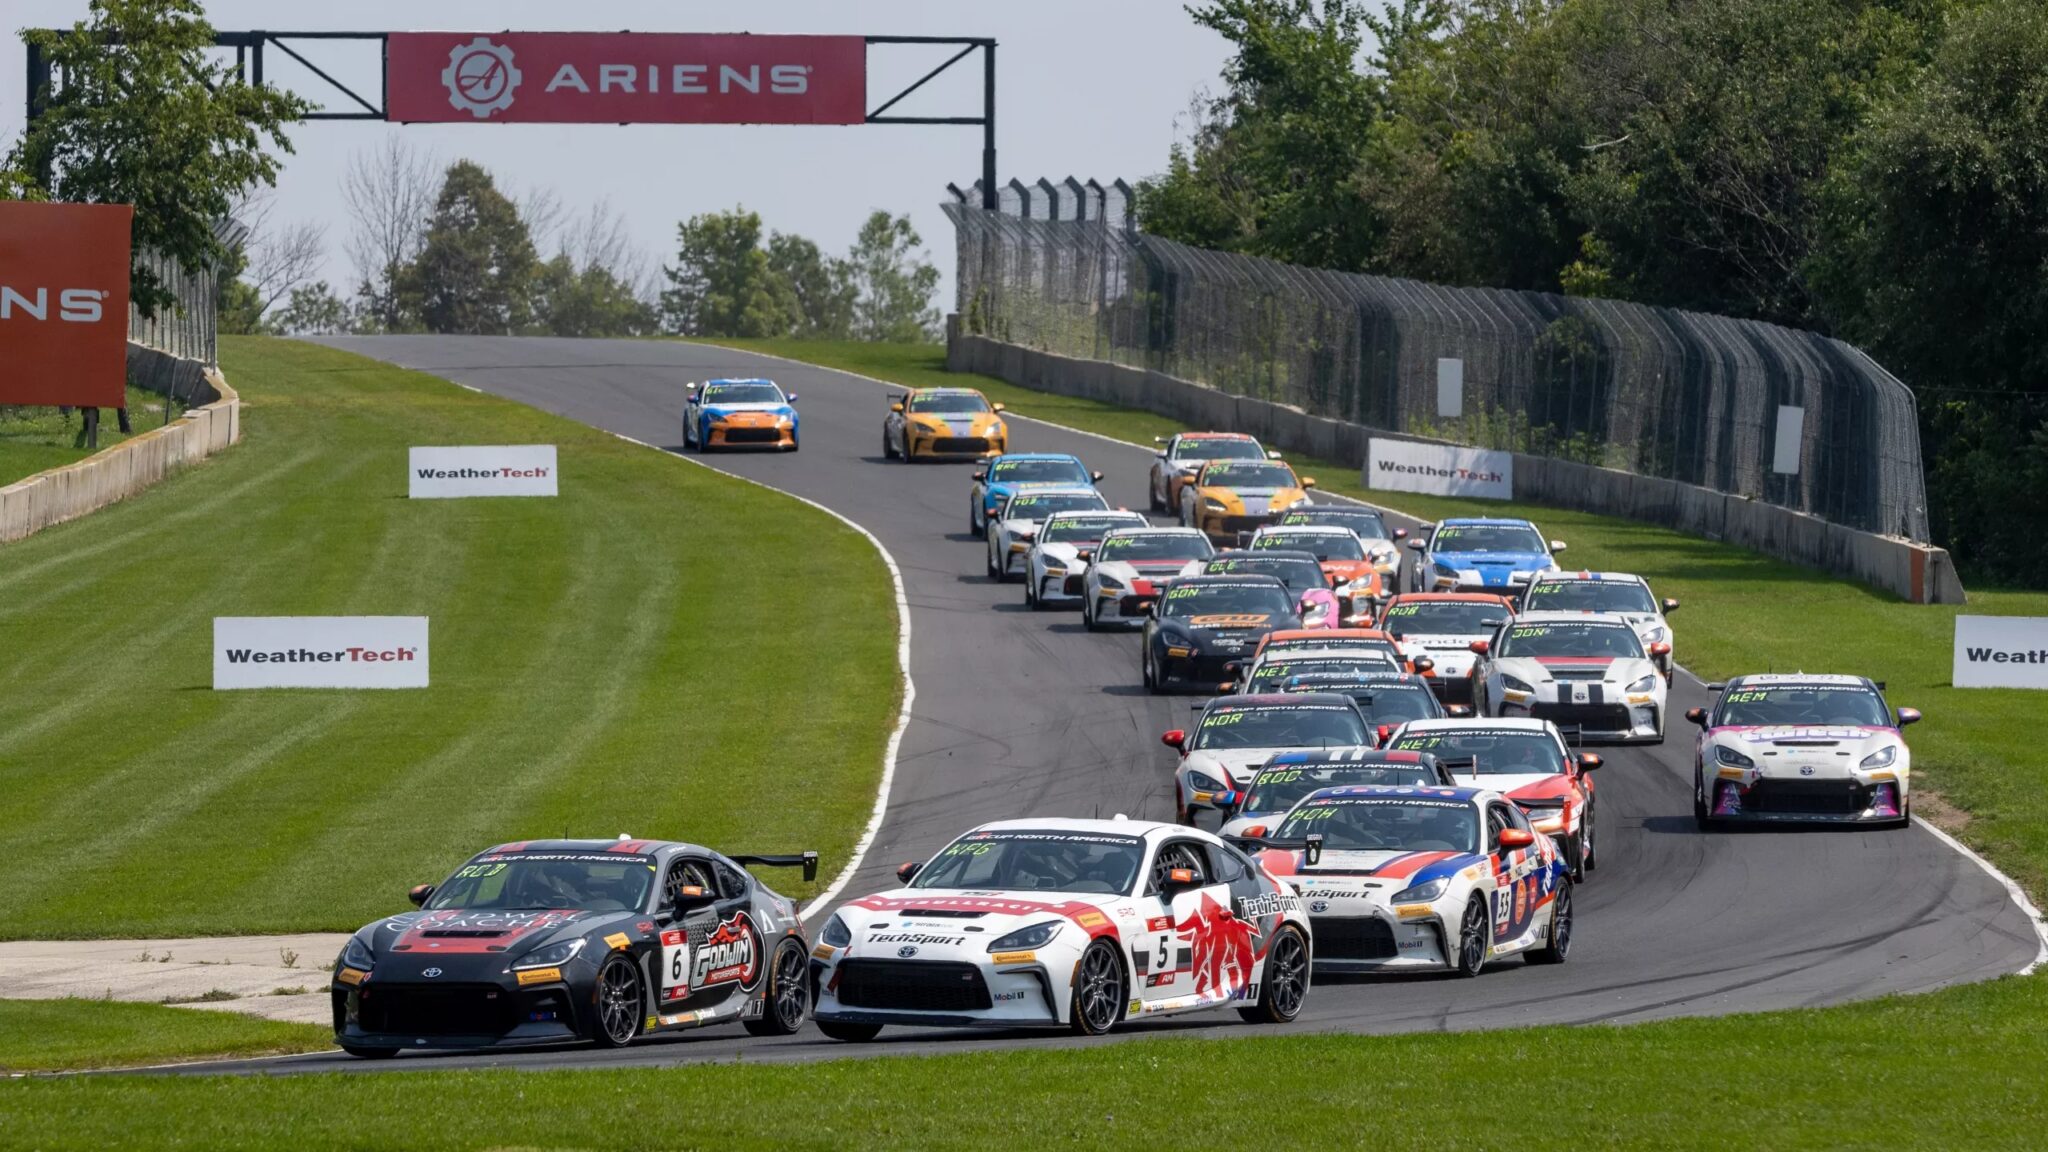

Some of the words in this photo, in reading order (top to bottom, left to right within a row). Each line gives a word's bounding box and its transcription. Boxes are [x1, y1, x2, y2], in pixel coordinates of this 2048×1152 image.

[545, 64, 809, 94] ARIENS
[417, 467, 547, 479] WeatherTech
[1378, 460, 1502, 482] WeatherTech
[226, 646, 415, 664] WeatherTech
[1255, 665, 1290, 678] WEI
[1203, 712, 1244, 728] WOR
[1317, 763, 1365, 771] NORTH
[1365, 763, 1424, 771] AMERICA
[1354, 799, 1404, 807] NORTH
[1404, 799, 1470, 808] AMERICA
[991, 833, 1013, 841] CUP
[1013, 833, 1067, 841] NORTH
[1066, 833, 1138, 845] AMERICA
[501, 854, 526, 862] CUP
[526, 853, 571, 862] NORTH
[572, 854, 648, 864] AMERICA
[1238, 892, 1301, 919] TechSpor
[1498, 891, 1510, 919] 55
[867, 932, 968, 947] TechSport
[1156, 935, 1169, 969] 5
[671, 949, 683, 981] 6
[994, 992, 1017, 1001] Mobil
